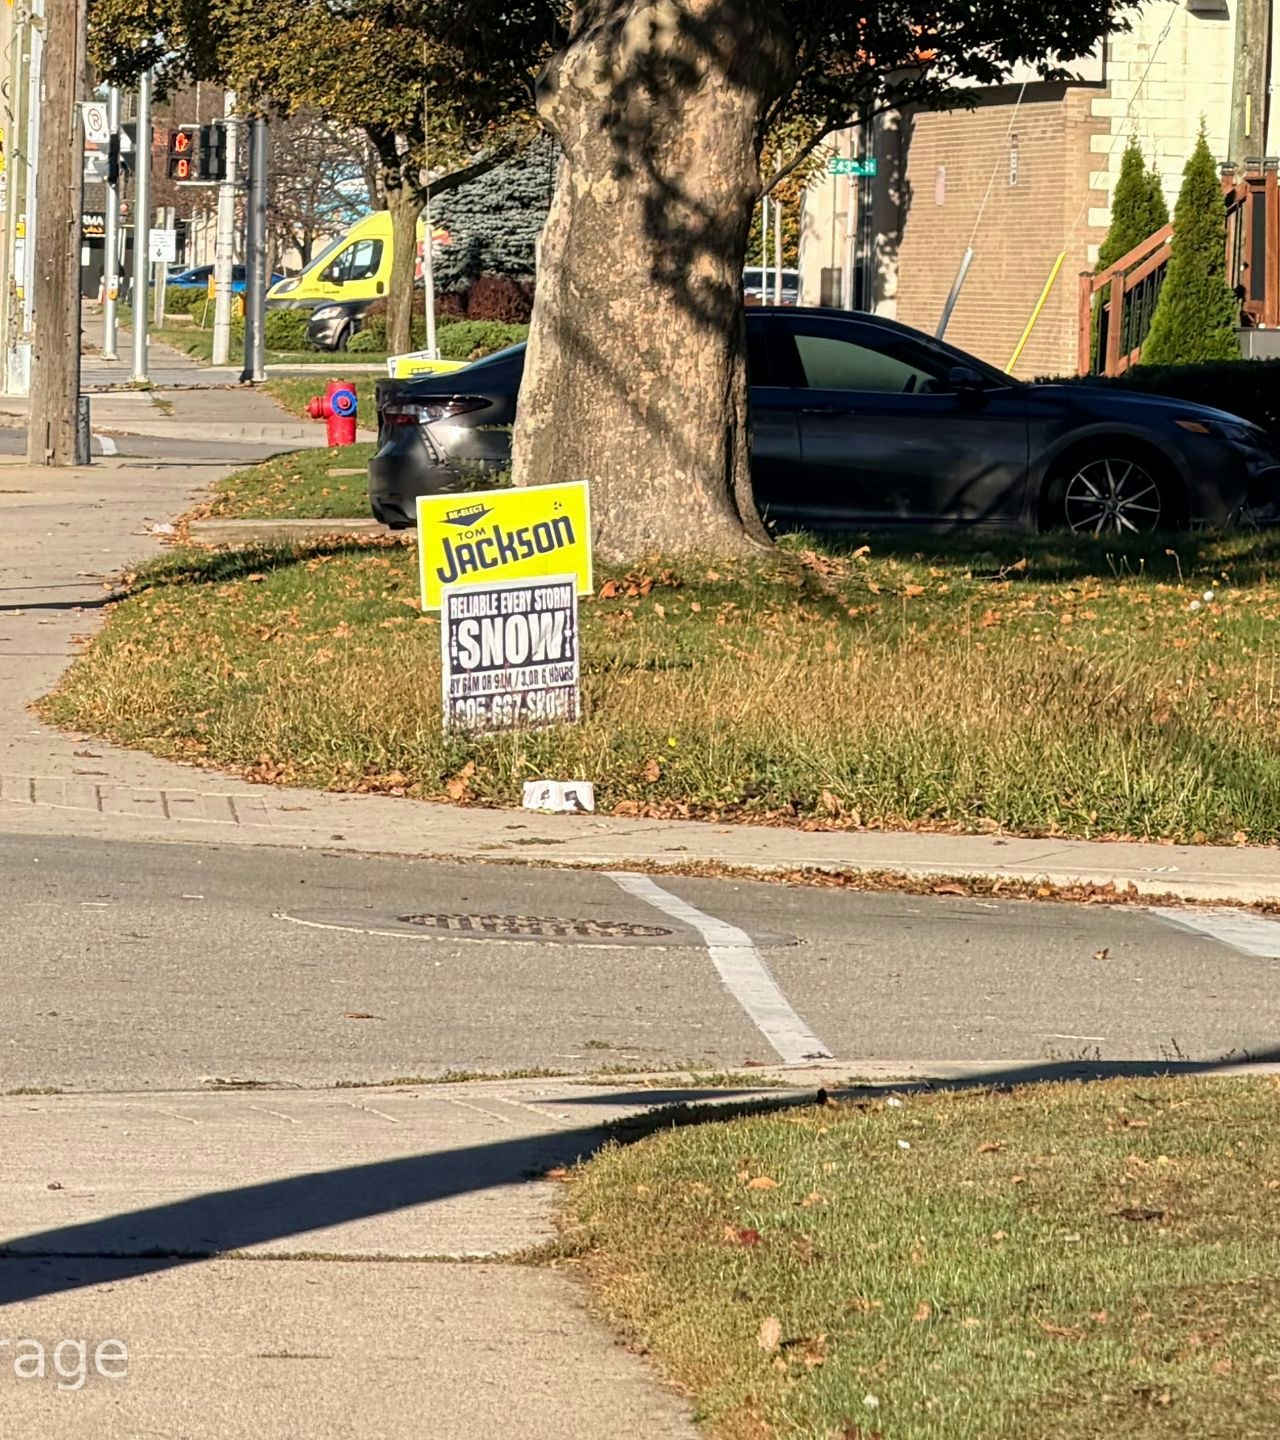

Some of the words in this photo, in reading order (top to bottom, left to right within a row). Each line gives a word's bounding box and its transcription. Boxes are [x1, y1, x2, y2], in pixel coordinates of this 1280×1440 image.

[448, 504, 484, 520] RE-ELECT
[457, 527, 486, 541] TOM
[436, 515, 576, 584] Jackson
[450, 593, 498, 619] RELIABLE
[500, 590, 532, 615] EVERY
[534, 586, 571, 611] STORM
[458, 610, 565, 669] SNOW
[482, 675, 492, 690] OR
